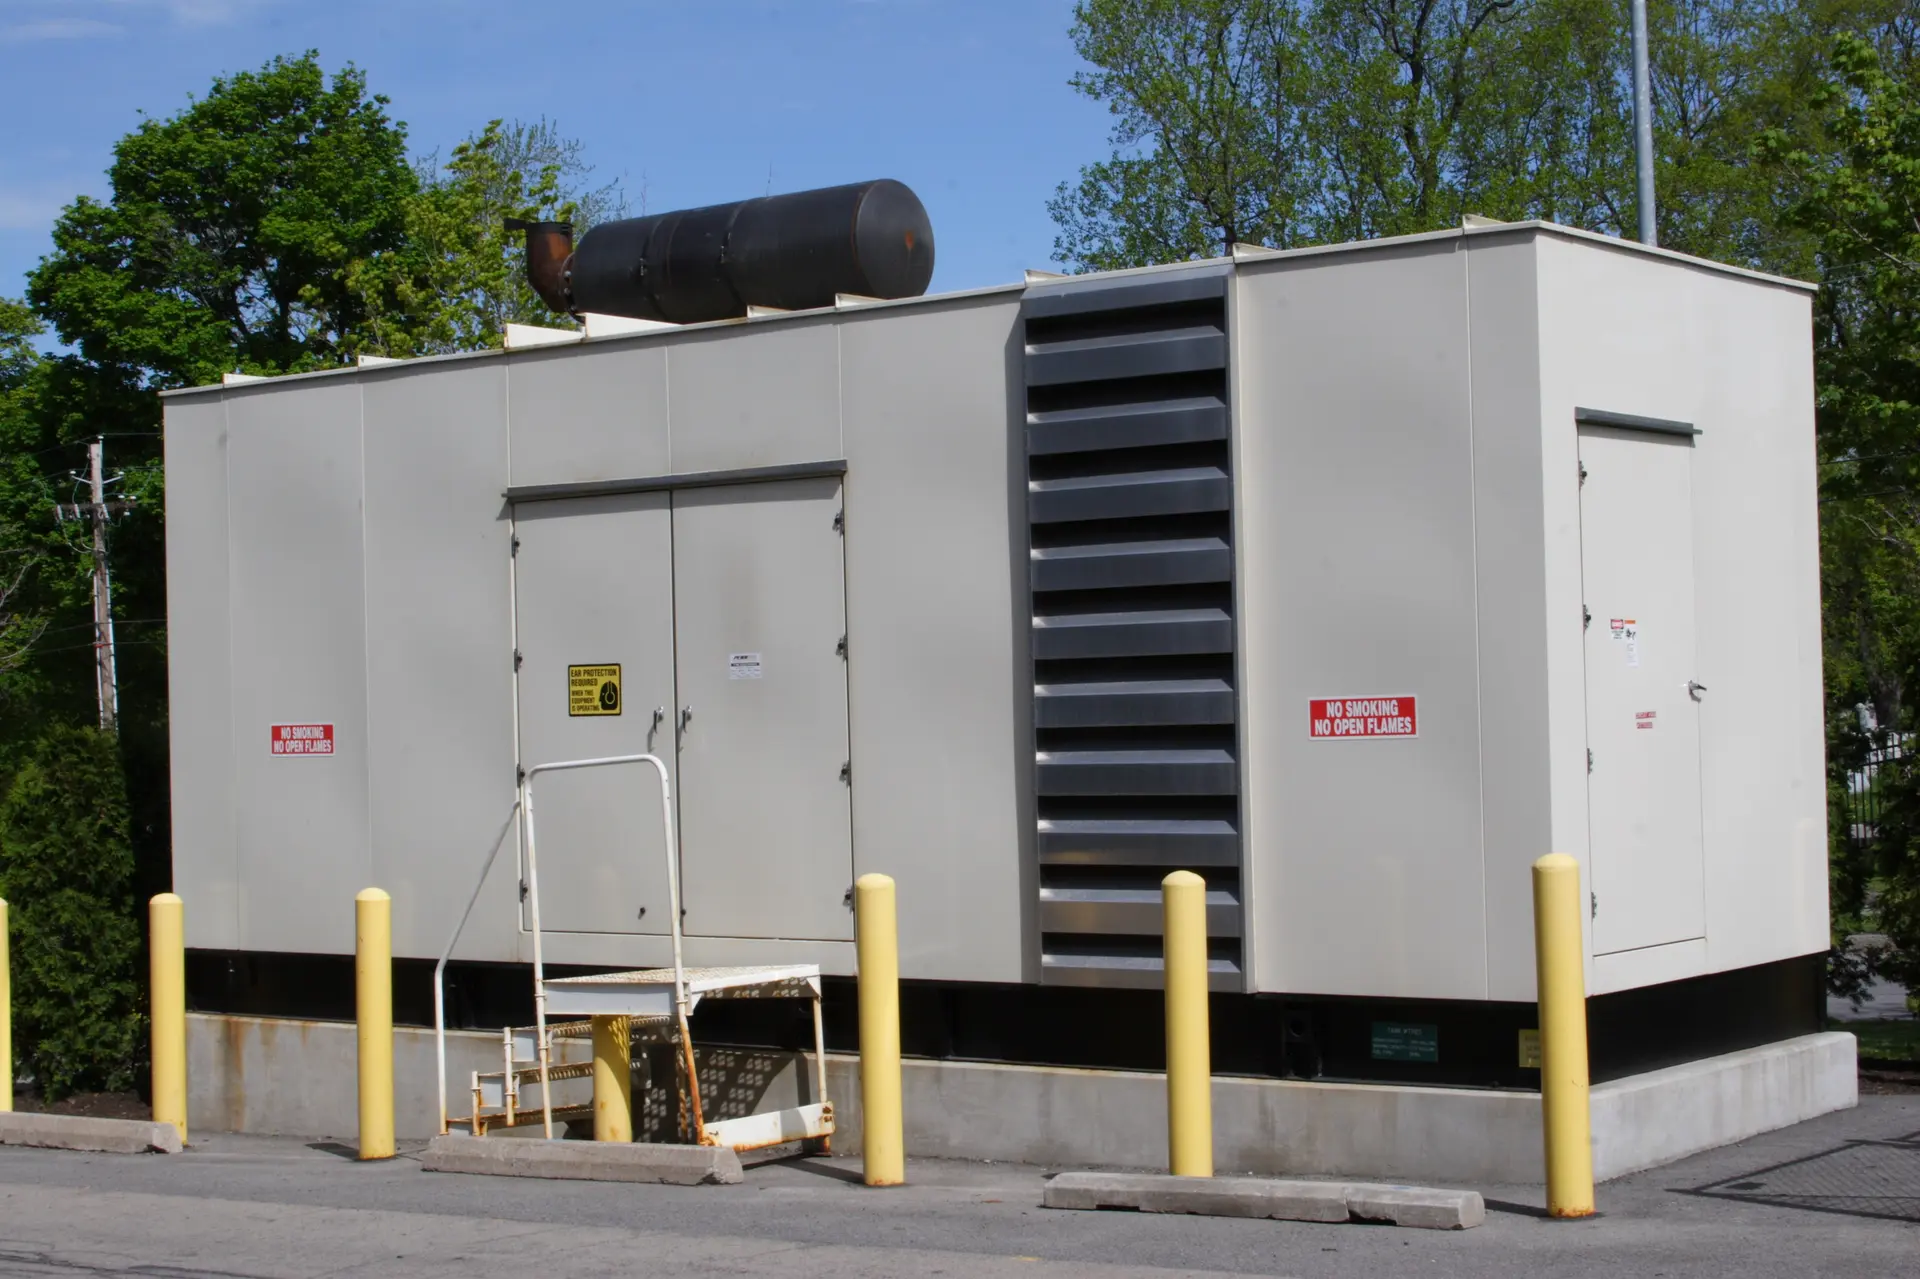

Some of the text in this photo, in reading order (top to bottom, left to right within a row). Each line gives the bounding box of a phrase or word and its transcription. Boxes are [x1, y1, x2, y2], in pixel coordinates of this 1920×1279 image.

[571, 668, 617, 677] EAR PROTECTION
[571, 678, 598, 687] REQUIRED
[1326, 699, 1398, 718] NO SMOKING
[1314, 716, 1412, 735] NO OPEN FLAMES
[281, 726, 324, 739] NO SMOKING
[274, 739, 331, 752] NO OPEN FLAMES
